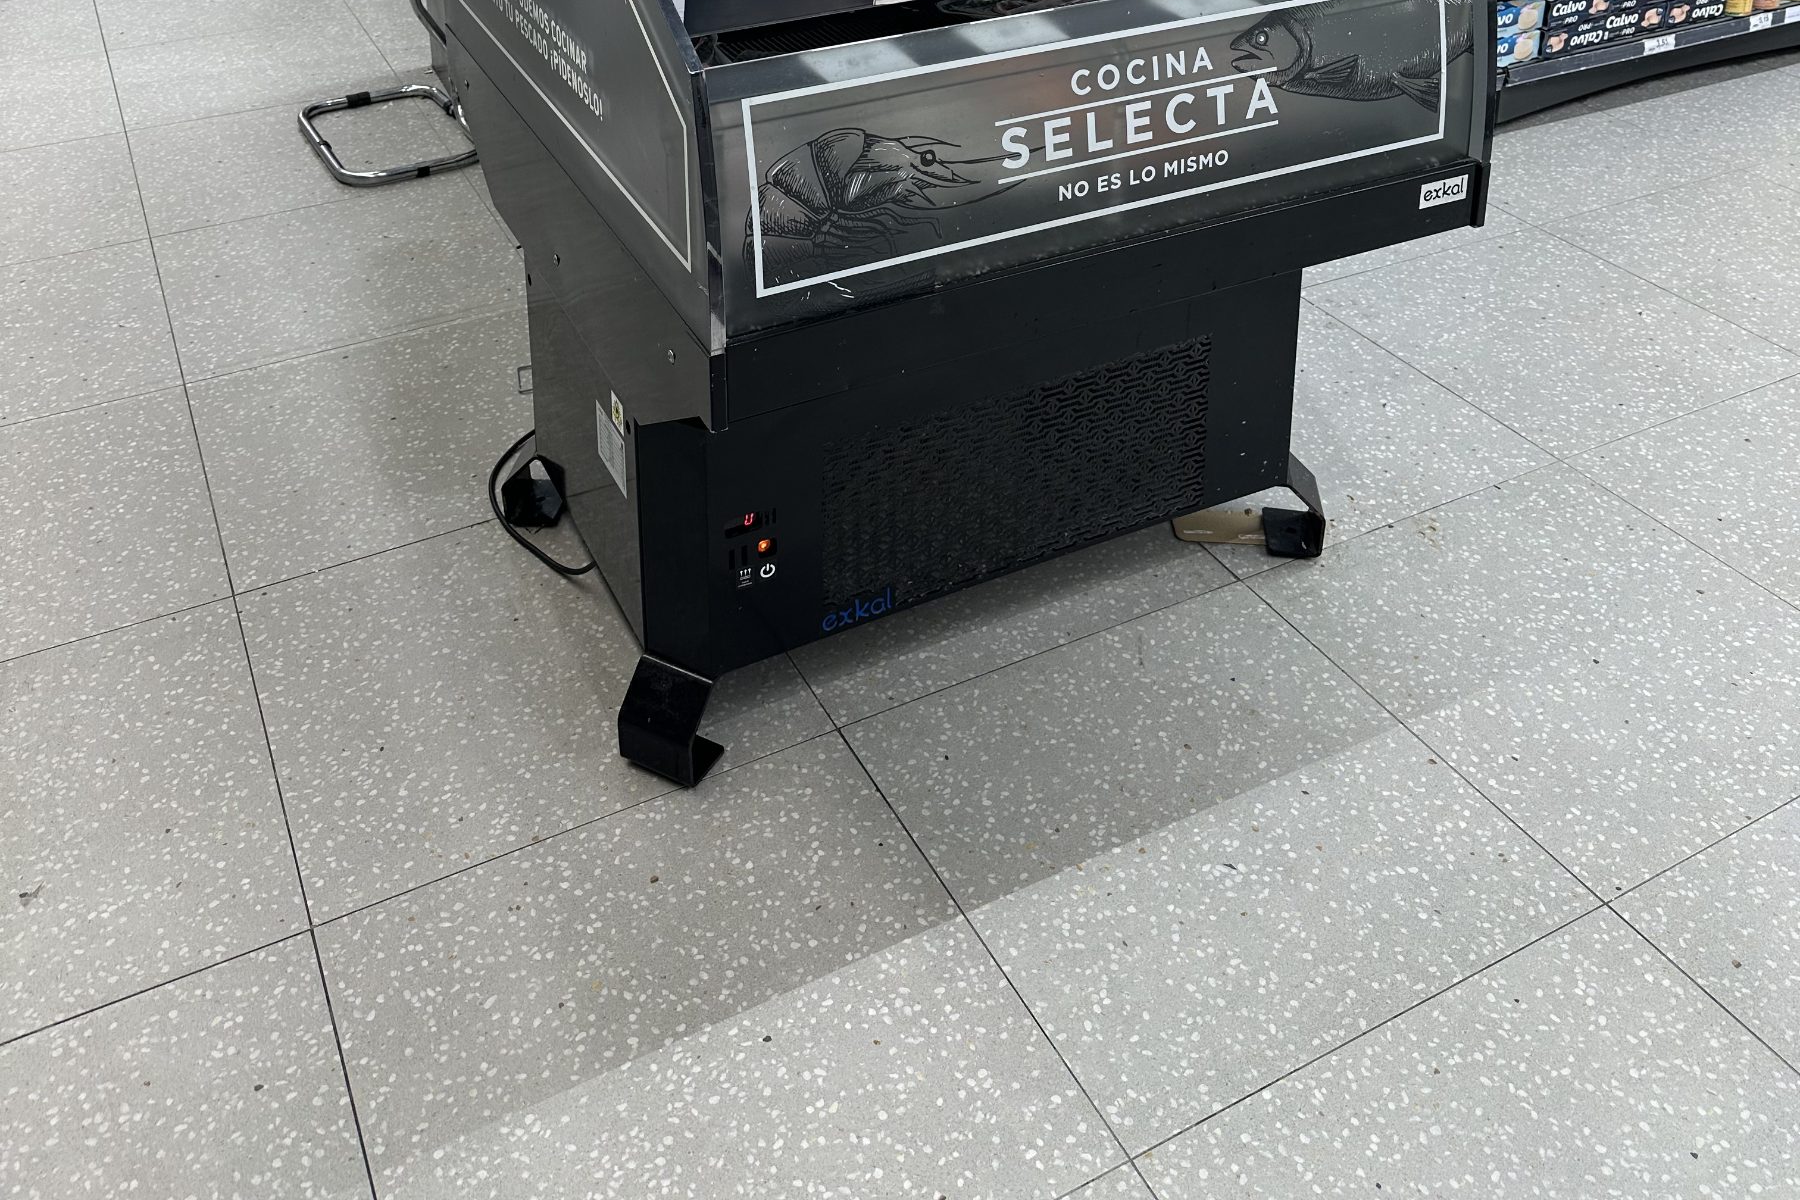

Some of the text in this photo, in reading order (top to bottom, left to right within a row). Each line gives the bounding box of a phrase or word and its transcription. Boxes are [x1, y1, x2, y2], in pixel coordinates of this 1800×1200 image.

[1552, 0, 1587, 17] Calvo
[1606, 13, 1639, 29] Calvo
[1692, 4, 1724, 19] Calvo
[514, 9, 548, 60] PESCADO
[551, 20, 587, 74] COCINAR
[1570, 30, 1603, 46] Calvo
[1071, 46, 1214, 96] COCINA
[1001, 77, 1280, 170] SELECTA
[1058, 150, 1230, 202] NO ES LO MISMO
[1424, 177, 1464, 202] exkal
[821, 587, 892, 632] exkal
